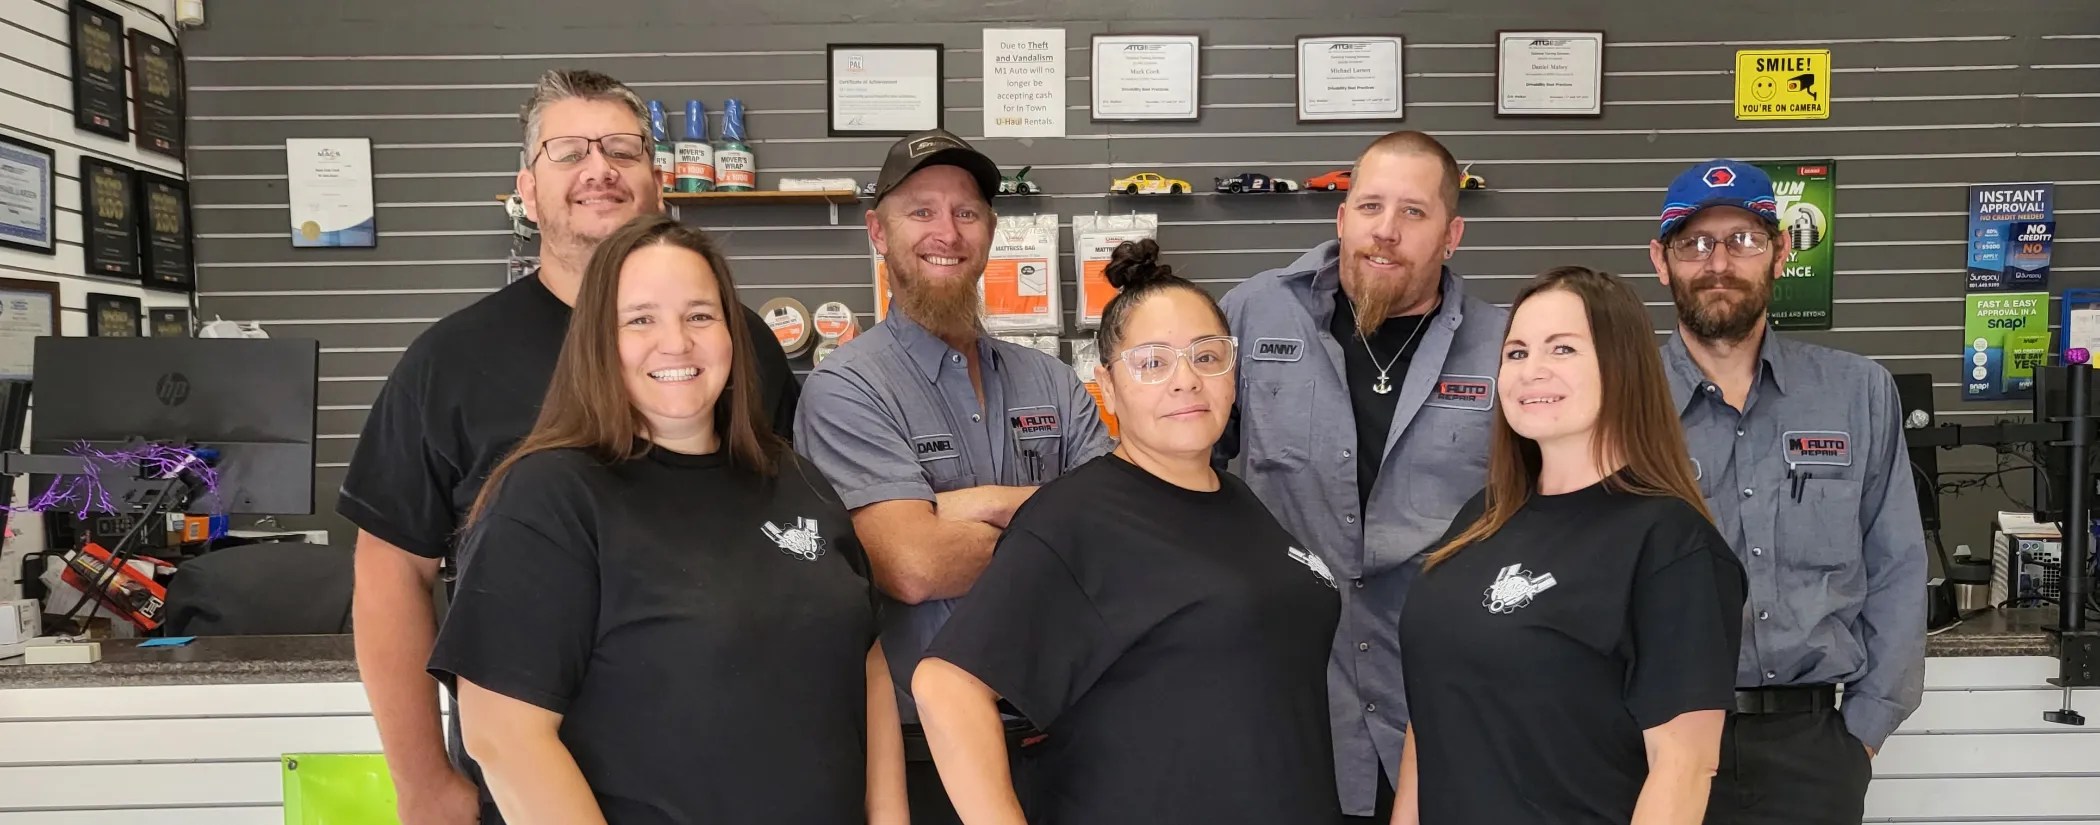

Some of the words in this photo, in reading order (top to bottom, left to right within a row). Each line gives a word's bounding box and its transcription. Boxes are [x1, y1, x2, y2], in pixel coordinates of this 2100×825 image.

[1000, 42, 1016, 50] Due
[1028, 41, 1049, 50] Theft
[996, 54, 1011, 62] and
[1012, 54, 1053, 62] Vandalism
[1756, 57, 1811, 72] SMILE!
[1029, 66, 1043, 74] will
[1006, 79, 1031, 88] longer
[1033, 79, 1043, 87] be
[997, 92, 1034, 101] accepting
[1035, 91, 1053, 99] cash
[1003, 104, 1014, 112] for
[1026, 104, 1047, 112] Town
[1743, 104, 1772, 112] YOU'RE
[1775, 104, 1787, 112] ON
[1789, 104, 1822, 112] CAMERA
[996, 118, 1022, 126] U-Haul
[679, 148, 705, 157] MOVER'S
[681, 155, 700, 163] WRAP
[721, 156, 748, 165] MOVER'S
[1980, 190, 2044, 203] INSTANT
[1980, 202, 2044, 213] APPROVAL!
[2027, 224, 2046, 234] NO
[2023, 243, 2042, 254] NO
[1969, 273, 2000, 282] Surepay
[1978, 300, 2001, 308] FAST
[2013, 299, 2037, 307] EASY
[1988, 317, 2026, 330] snap!
[1260, 343, 1297, 355] DANNY
[917, 440, 954, 454] DANIEL
